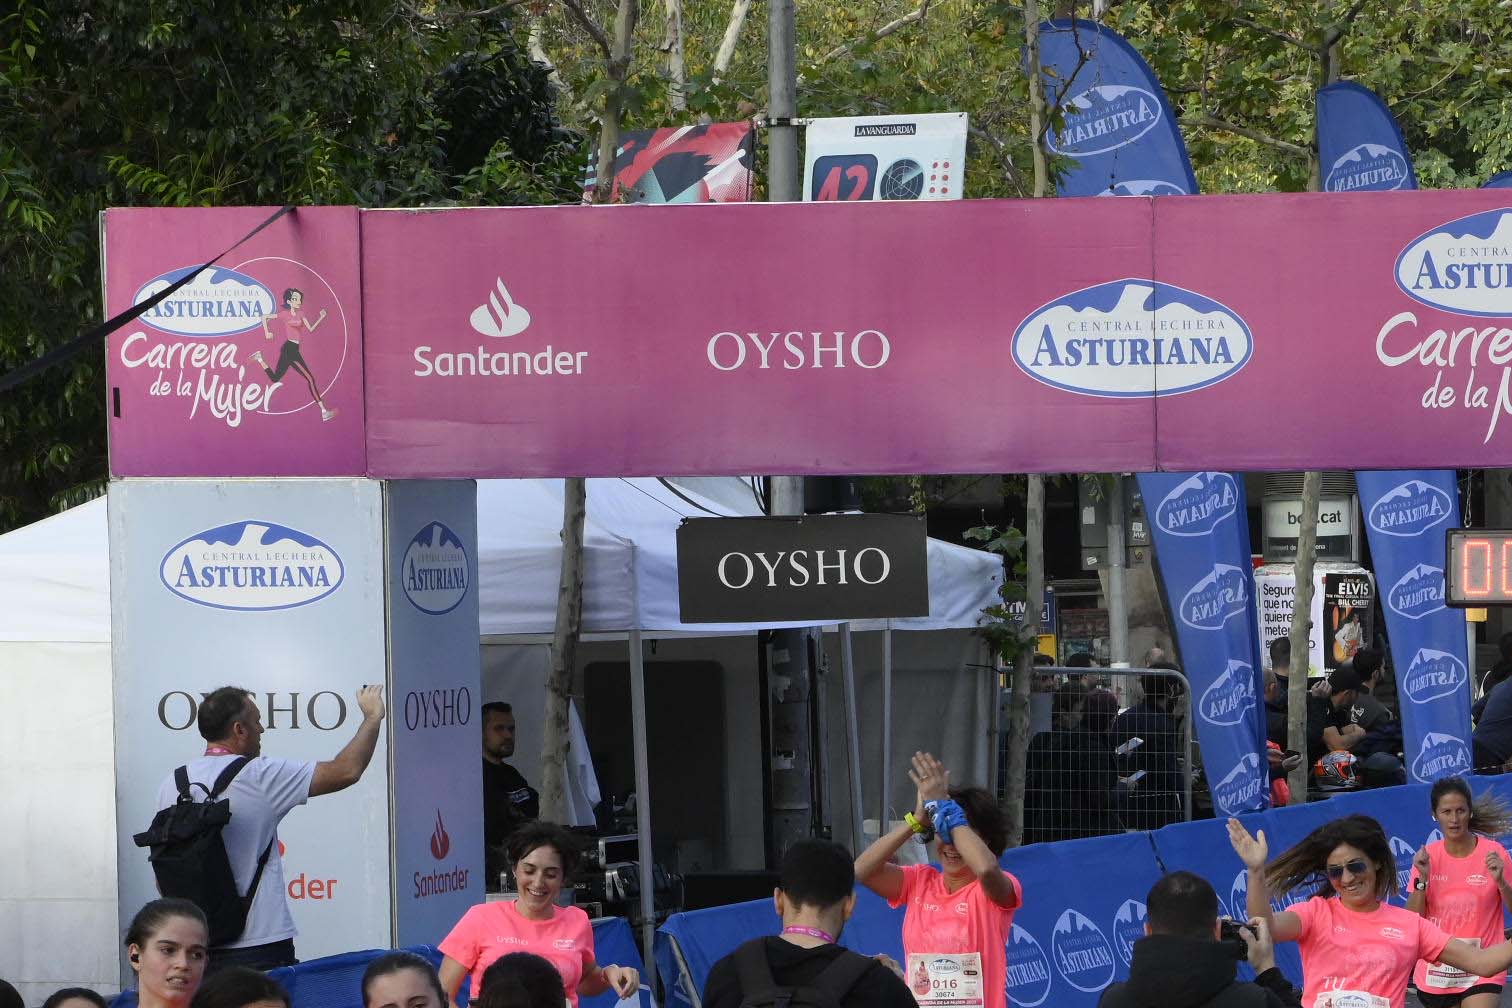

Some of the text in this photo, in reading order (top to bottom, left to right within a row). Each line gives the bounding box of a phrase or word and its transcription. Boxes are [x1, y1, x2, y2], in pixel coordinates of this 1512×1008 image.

[176, 287, 209, 297] ENTRAL
[1068, 318, 1225, 332] CENTRAL LECHERA
[121, 332, 239, 369] Carrera
[414, 346, 588, 377] Santander
[707, 330, 890, 371] OYSHO
[1031, 323, 1234, 367] ASTURIANA
[150, 367, 284, 428] de la Mujer
[1421, 370, 1457, 409] de
[1464, 368, 1489, 408] la
[174, 555, 331, 589] ASTURIANA
[203, 551, 324, 562] CENTRAL LECHERA
[717, 547, 890, 591] OYSHO
[408, 557, 465, 591] ASTURIANA
[1338, 583, 1368, 595] ELVIS
[1264, 600, 1279, 611] que
[158, 690, 347, 731] OHO
[405, 686, 470, 731] OYSHO
[413, 866, 469, 899] Santander
[1058, 943, 1112, 975] ASTURIANA
[932, 979, 958, 989] 016
